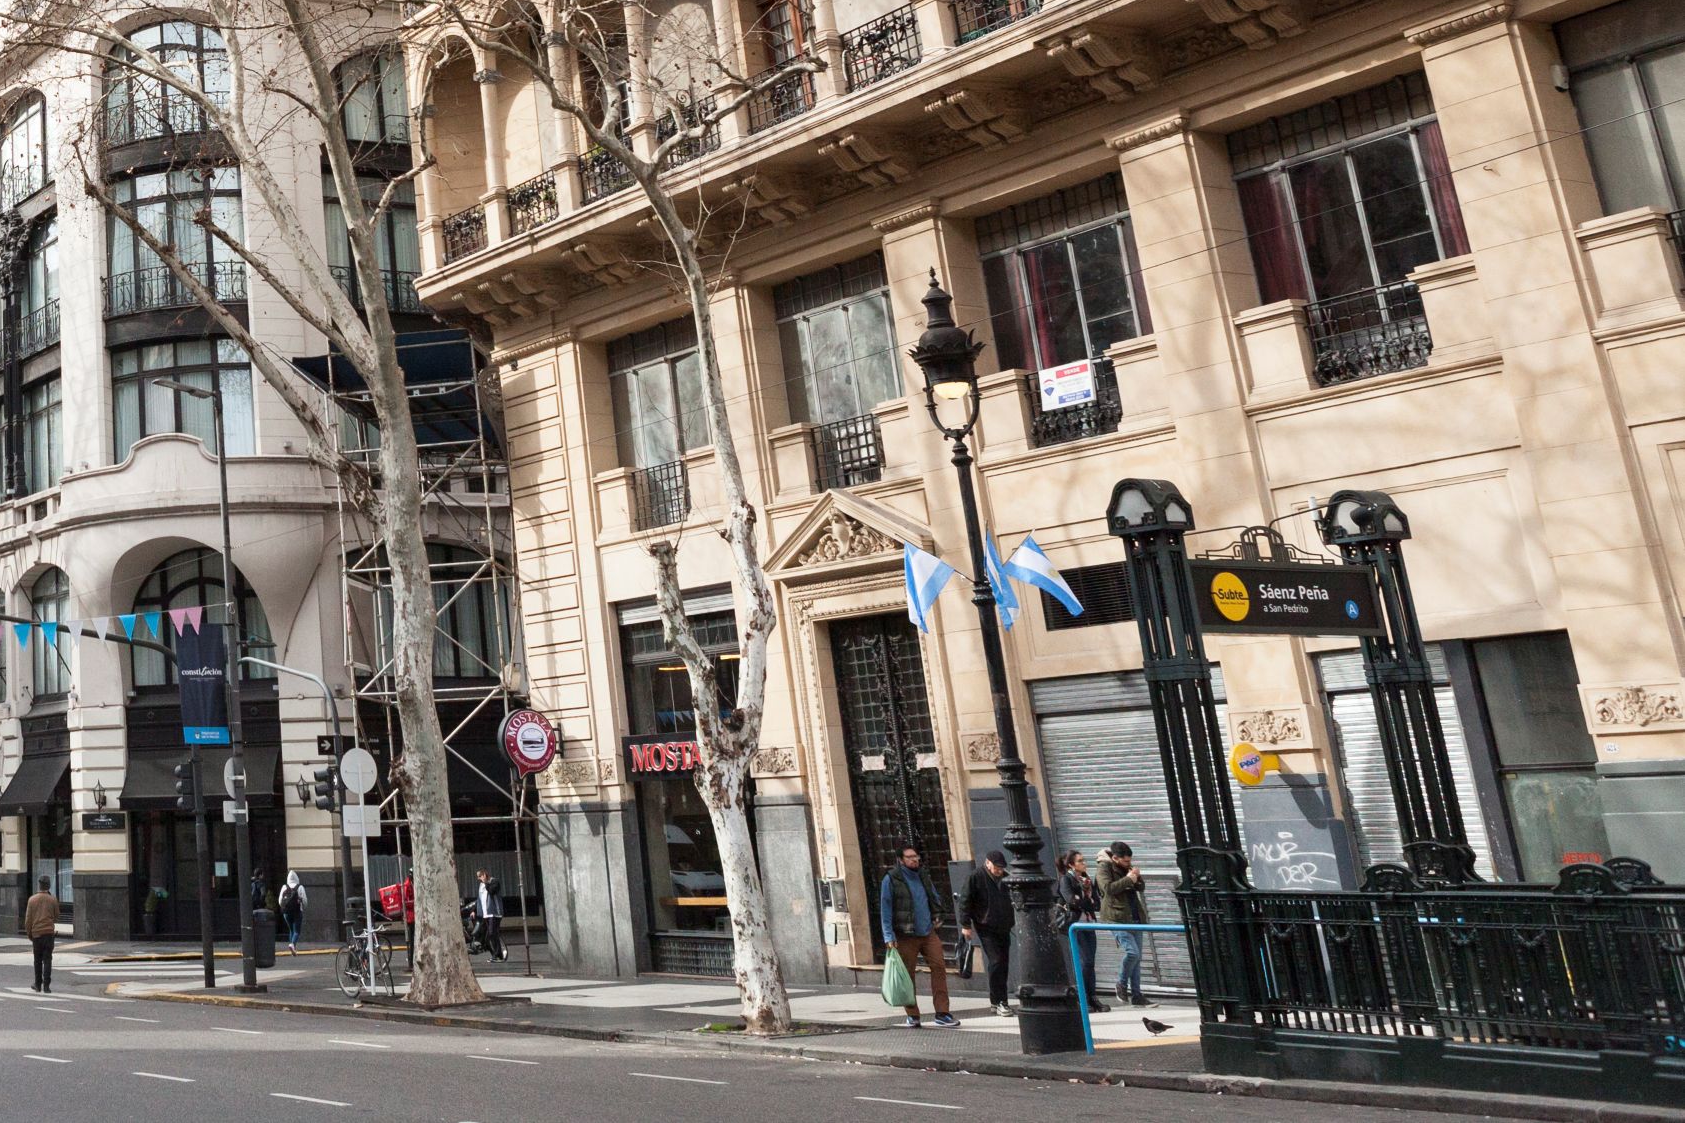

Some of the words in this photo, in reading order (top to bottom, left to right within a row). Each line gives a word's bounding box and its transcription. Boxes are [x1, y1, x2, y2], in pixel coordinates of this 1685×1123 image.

[1217, 588, 1243, 600] Subte
[1258, 584, 1297, 600] Sáenz
[1298, 585, 1330, 601] Peña
[1263, 605, 1268, 613] a
[1269, 604, 1282, 613] San
[1283, 604, 1309, 614] Pedrito
[1348, 604, 1357, 614] A
[507, 712, 552, 738] MOSTAZA
